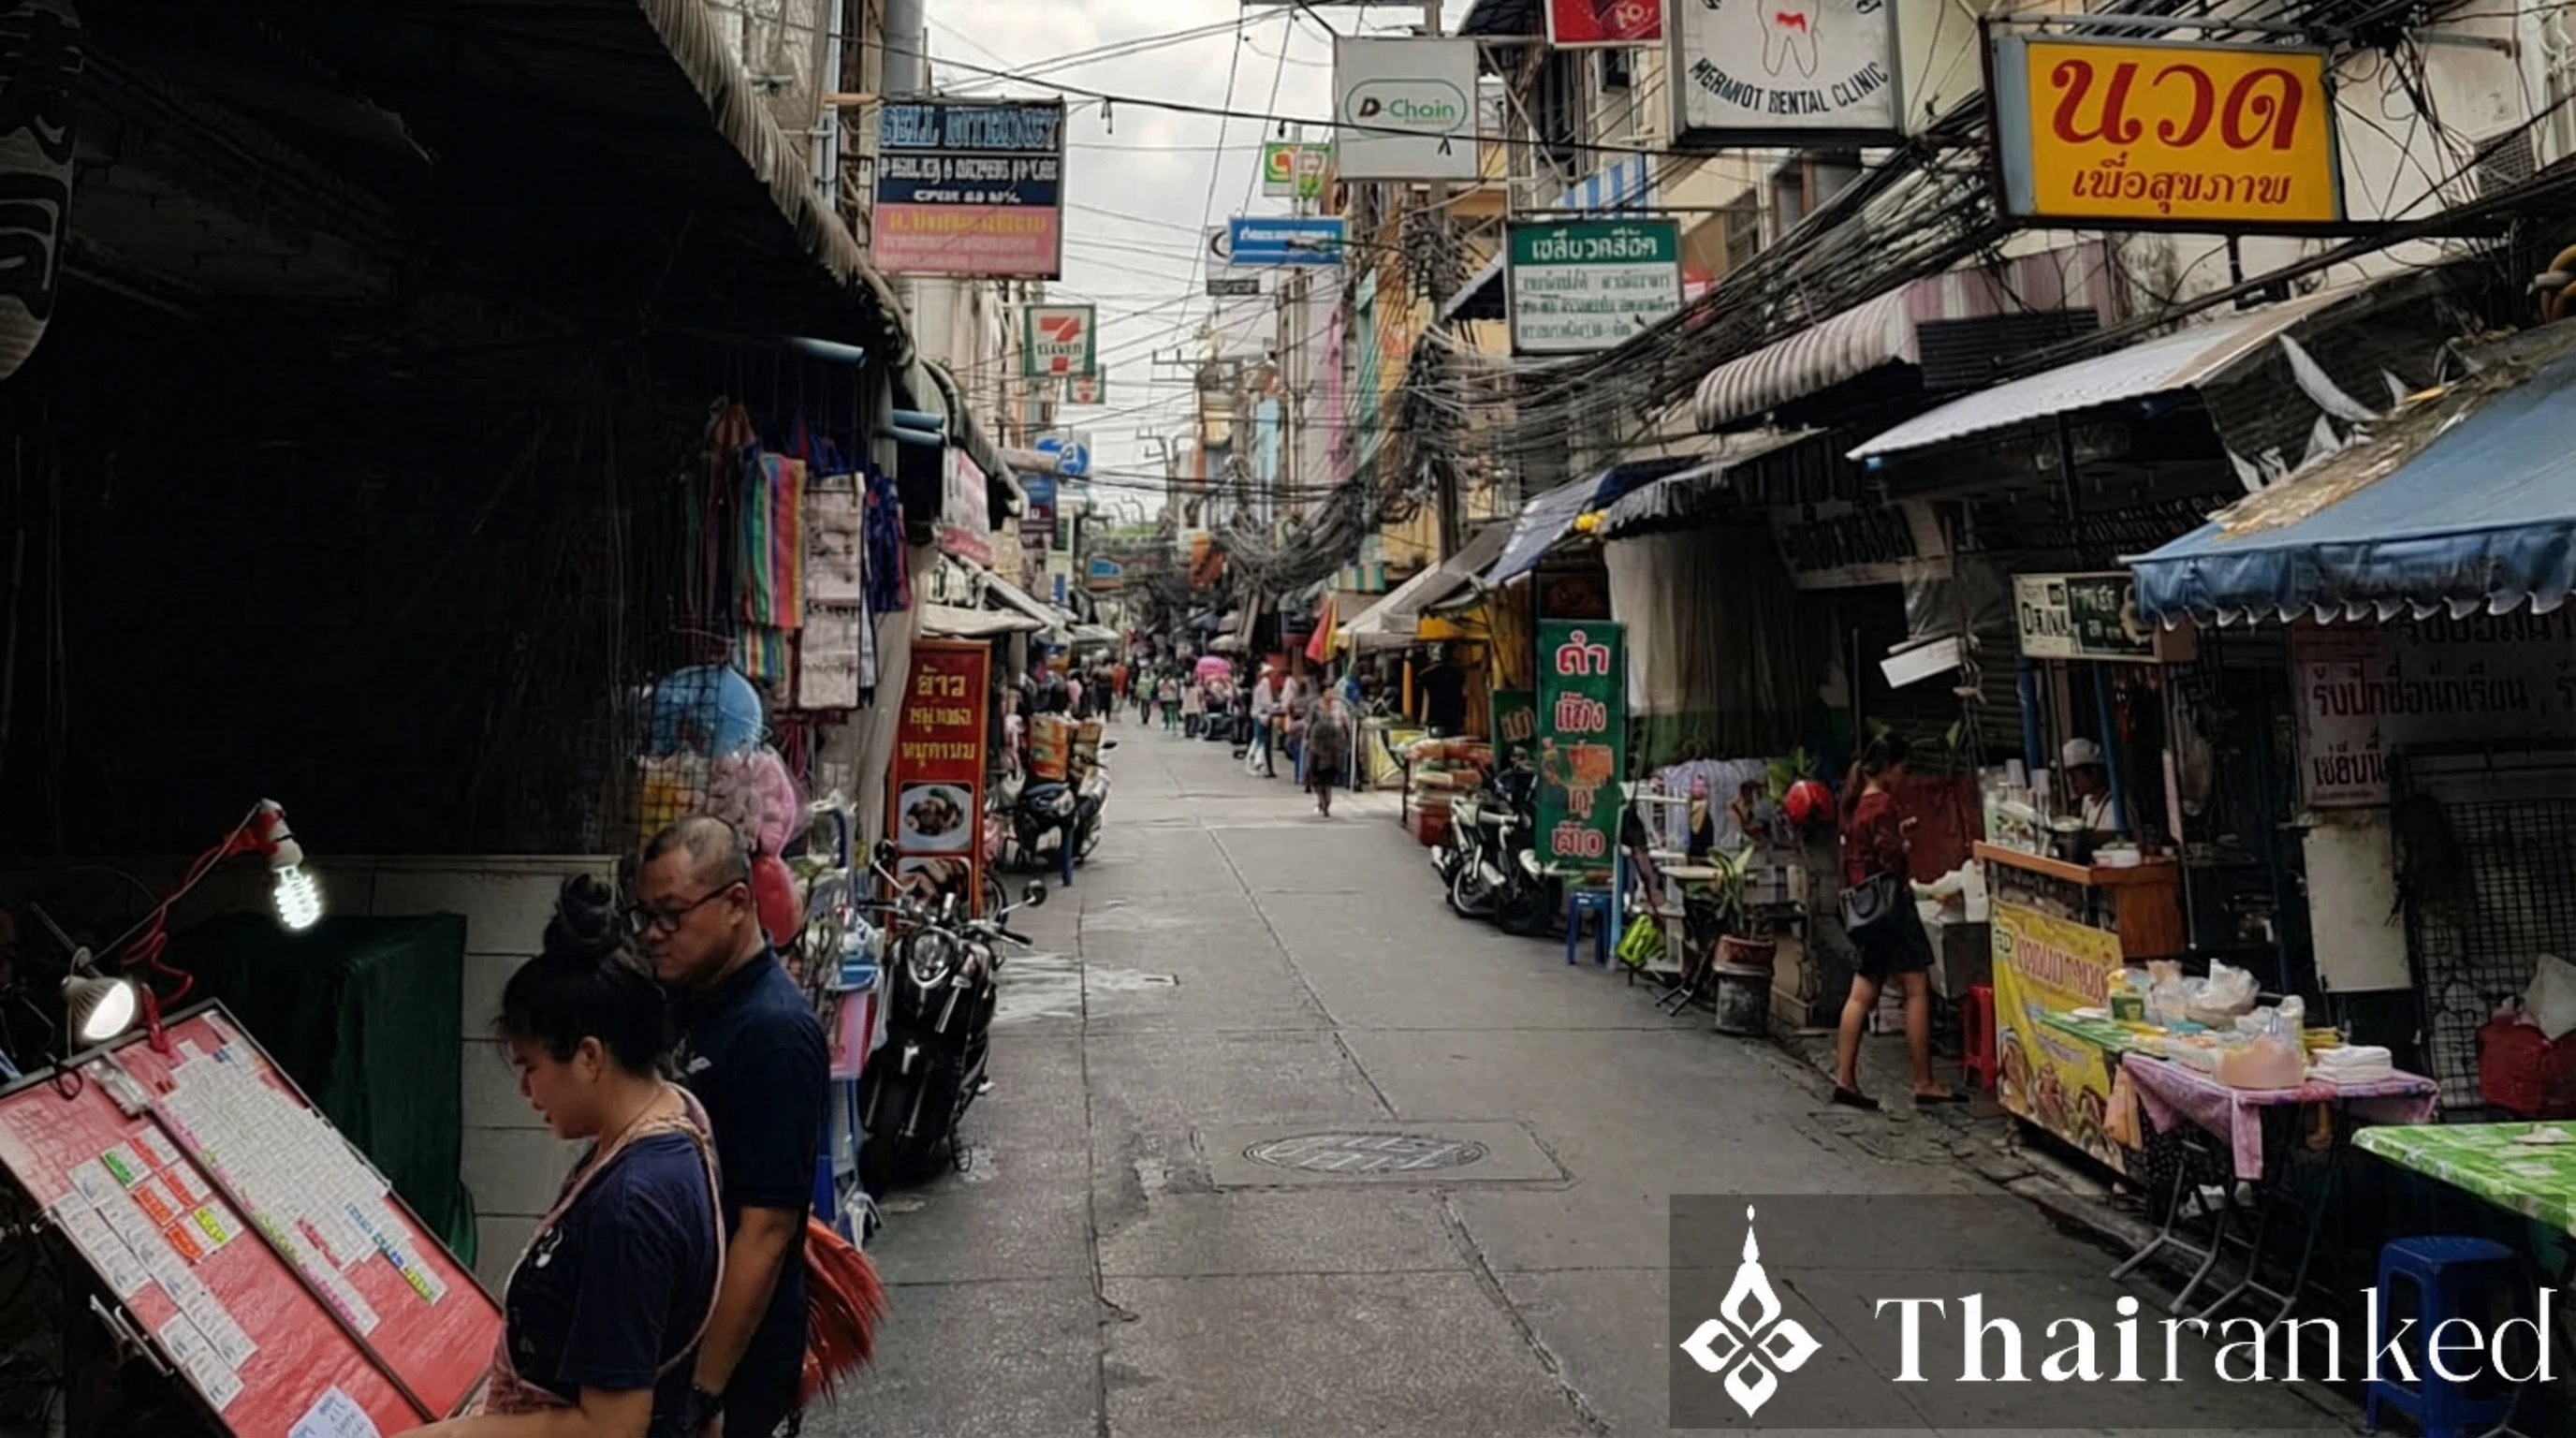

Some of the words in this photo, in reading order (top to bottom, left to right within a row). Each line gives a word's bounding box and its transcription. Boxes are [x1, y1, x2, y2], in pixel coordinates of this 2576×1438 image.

[1358, 96, 1456, 119] D-Chain
[1832, 61, 1889, 108] CLINIC
[2051, 58, 2304, 150] นวด
[2072, 151, 2292, 213] เพื่อสุขภาพ
